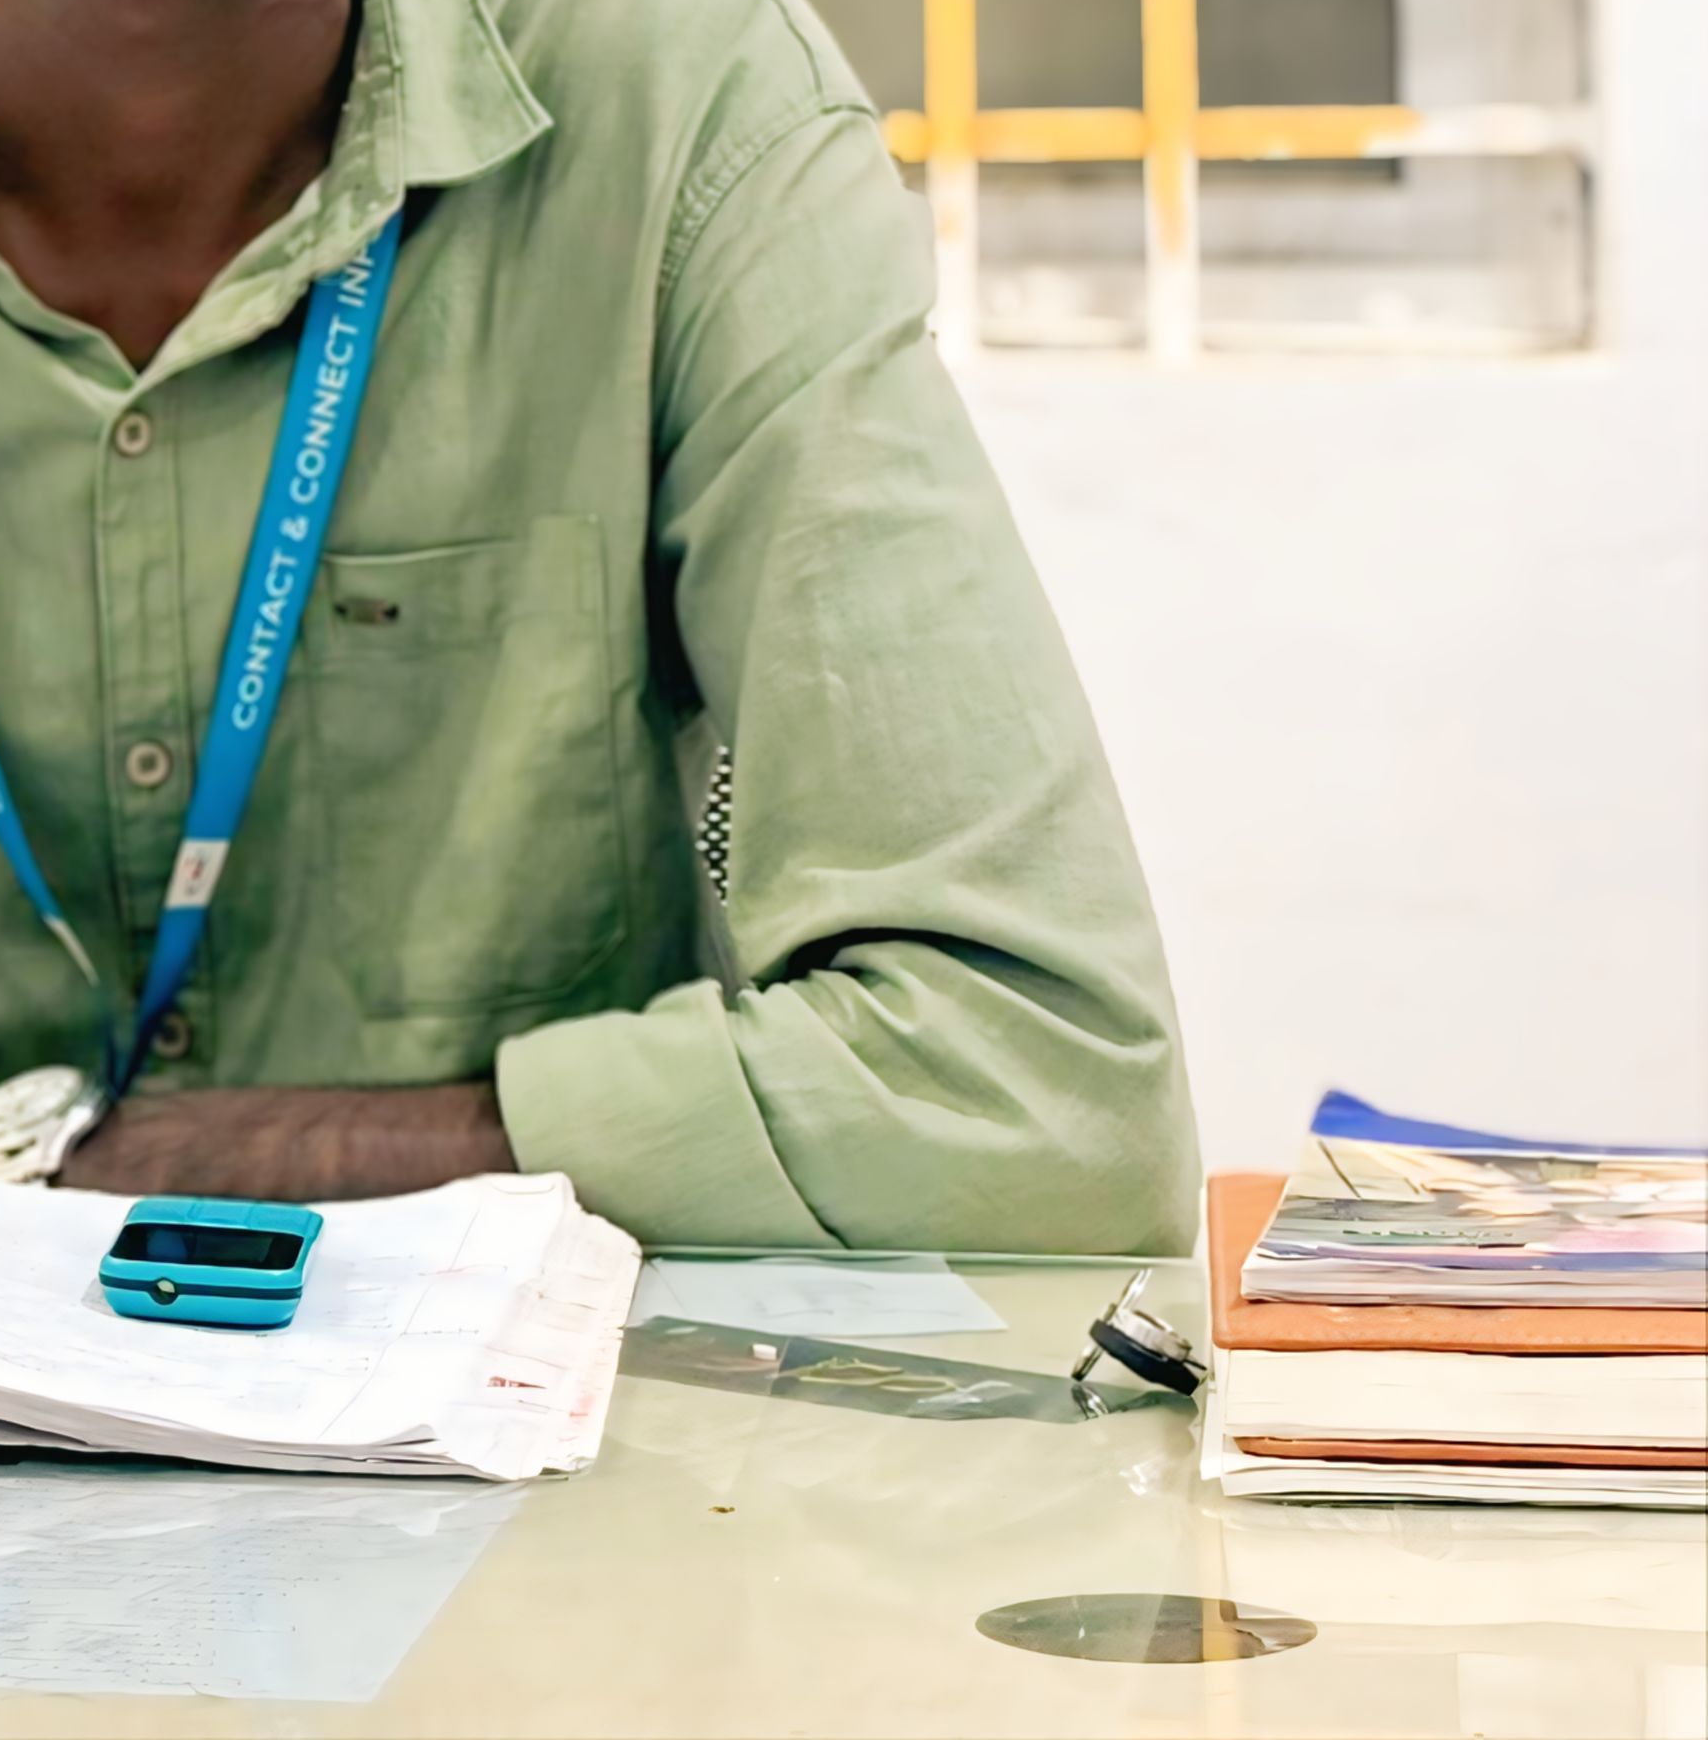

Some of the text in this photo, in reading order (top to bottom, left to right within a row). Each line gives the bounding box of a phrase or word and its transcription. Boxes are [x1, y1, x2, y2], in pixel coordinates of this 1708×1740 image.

[289, 314, 360, 506] CONNECT
[279, 513, 310, 543] &
[231, 546, 300, 731] CONTACT
